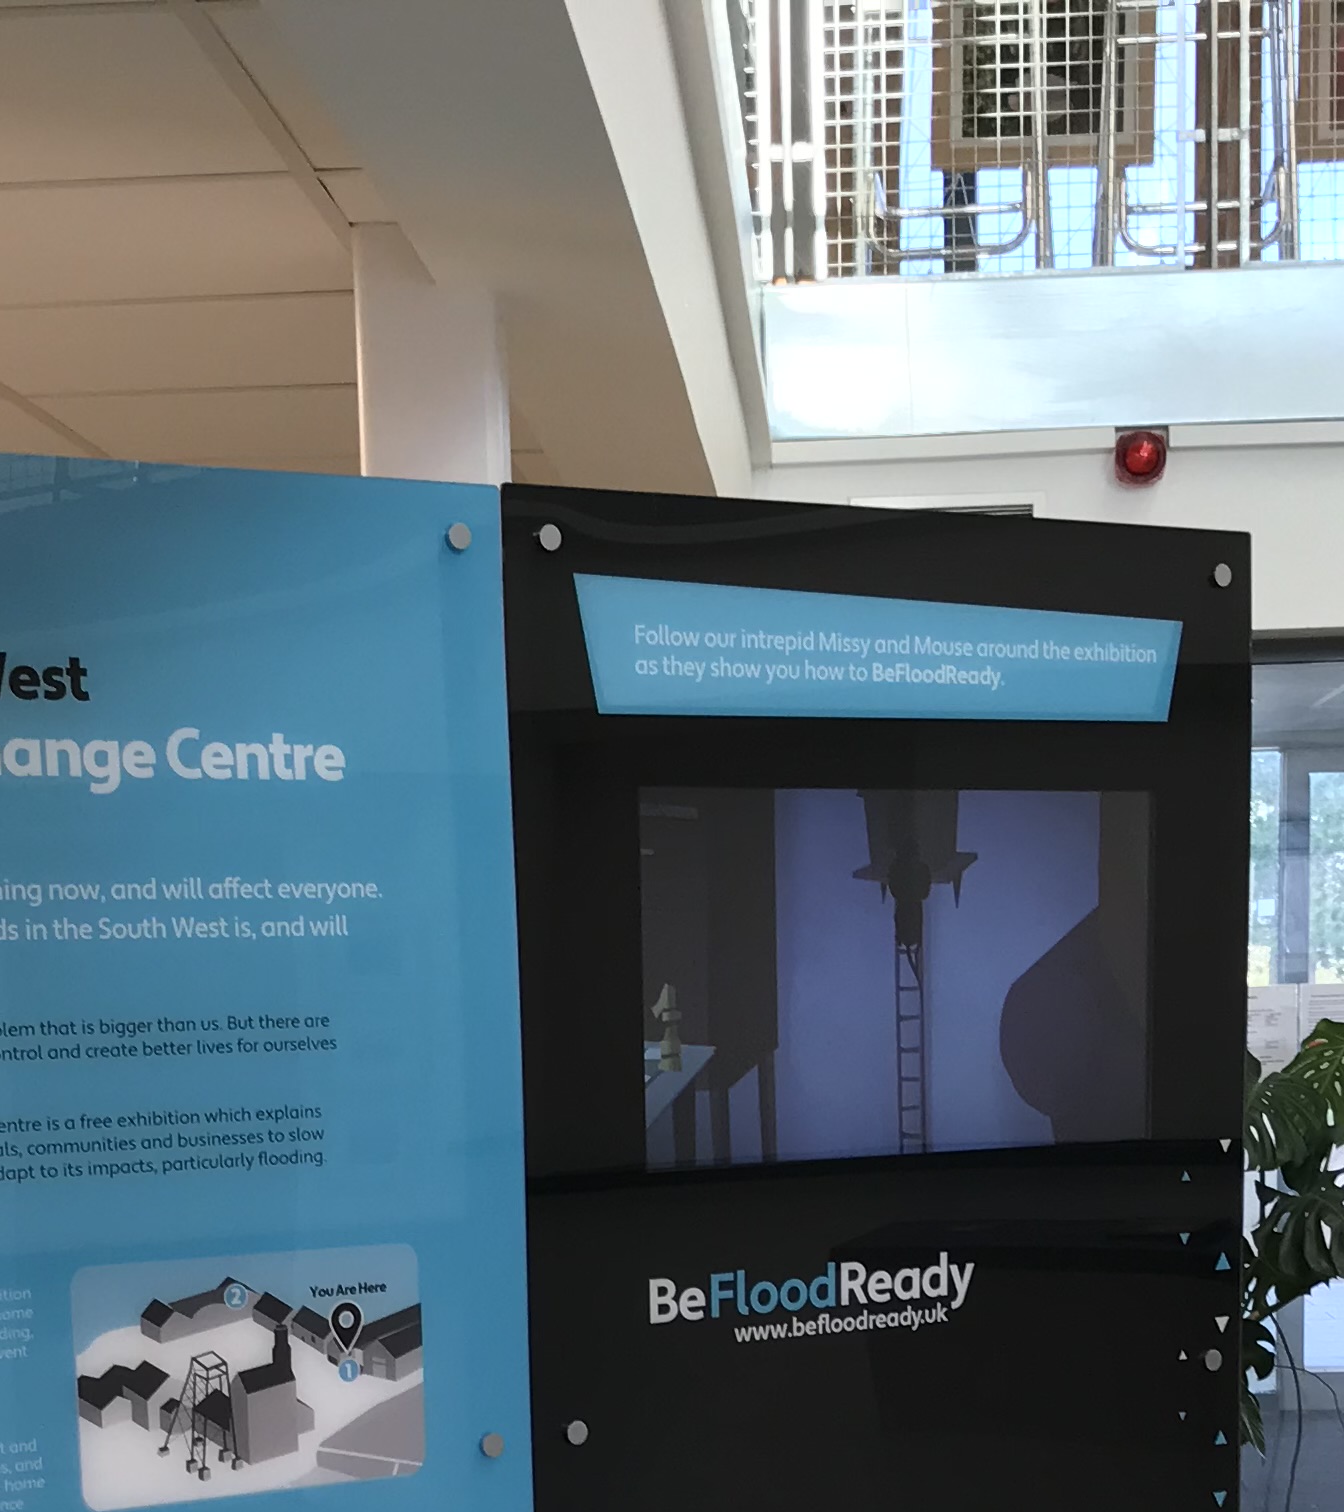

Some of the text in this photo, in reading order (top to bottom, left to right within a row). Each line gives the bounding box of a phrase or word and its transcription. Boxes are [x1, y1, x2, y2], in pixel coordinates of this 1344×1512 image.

[634, 623, 1157, 663] Follow our intrepid Missy and Mouse around the exhibition
[634, 654, 1005, 691] as they show you how to BeFloodReady.
[164, 726, 346, 781] Centre
[48, 883, 106, 903] now,
[110, 876, 157, 900] and
[160, 876, 204, 900] will
[207, 875, 273, 899] affect
[277, 881, 383, 904] everyone.
[24, 918, 48, 940] in
[51, 916, 93, 940] the
[97, 915, 166, 939] South
[170, 916, 230, 938] West
[233, 915, 256, 940] is,
[260, 914, 304, 937] and
[308, 913, 348, 936] will
[38, 1019, 77, 1036] that
[81, 1019, 95, 1035] is
[98, 1018, 153, 1038] bigger
[156, 1016, 196, 1032] than
[200, 1019, 223, 1031] us.
[226, 1014, 254, 1030] But
[258, 1013, 300, 1029] there
[303, 1015, 330, 1028] are
[46, 1042, 80, 1060] and
[84, 1042, 138, 1058] create
[141, 1040, 192, 1056] better
[196, 1039, 233, 1055] lives
[236, 1037, 258, 1053] for
[262, 1035, 337, 1052] ourselves
[46, 1116, 60, 1131] is
[63, 1117, 75, 1130] a
[79, 1113, 112, 1129] free
[116, 1109, 200, 1128] exhibition
[203, 1106, 251, 1123] which
[254, 1103, 322, 1124] explains
[26, 1136, 136, 1156] communities
[140, 1132, 172, 1150] and
[176, 1131, 264, 1148] businesses
[266, 1128, 285, 1143] to
[288, 1126, 324, 1142] slow
[39, 1164, 58, 1178] to
[62, 1162, 83, 1177] its
[87, 1158, 158, 1178] impacts,
[161, 1151, 254, 1175] particularly
[309, 1281, 387, 1298] You Are Here
[649, 1251, 975, 1324] BeFloodReady
[734, 1302, 948, 1342] www.befloodready.uk
